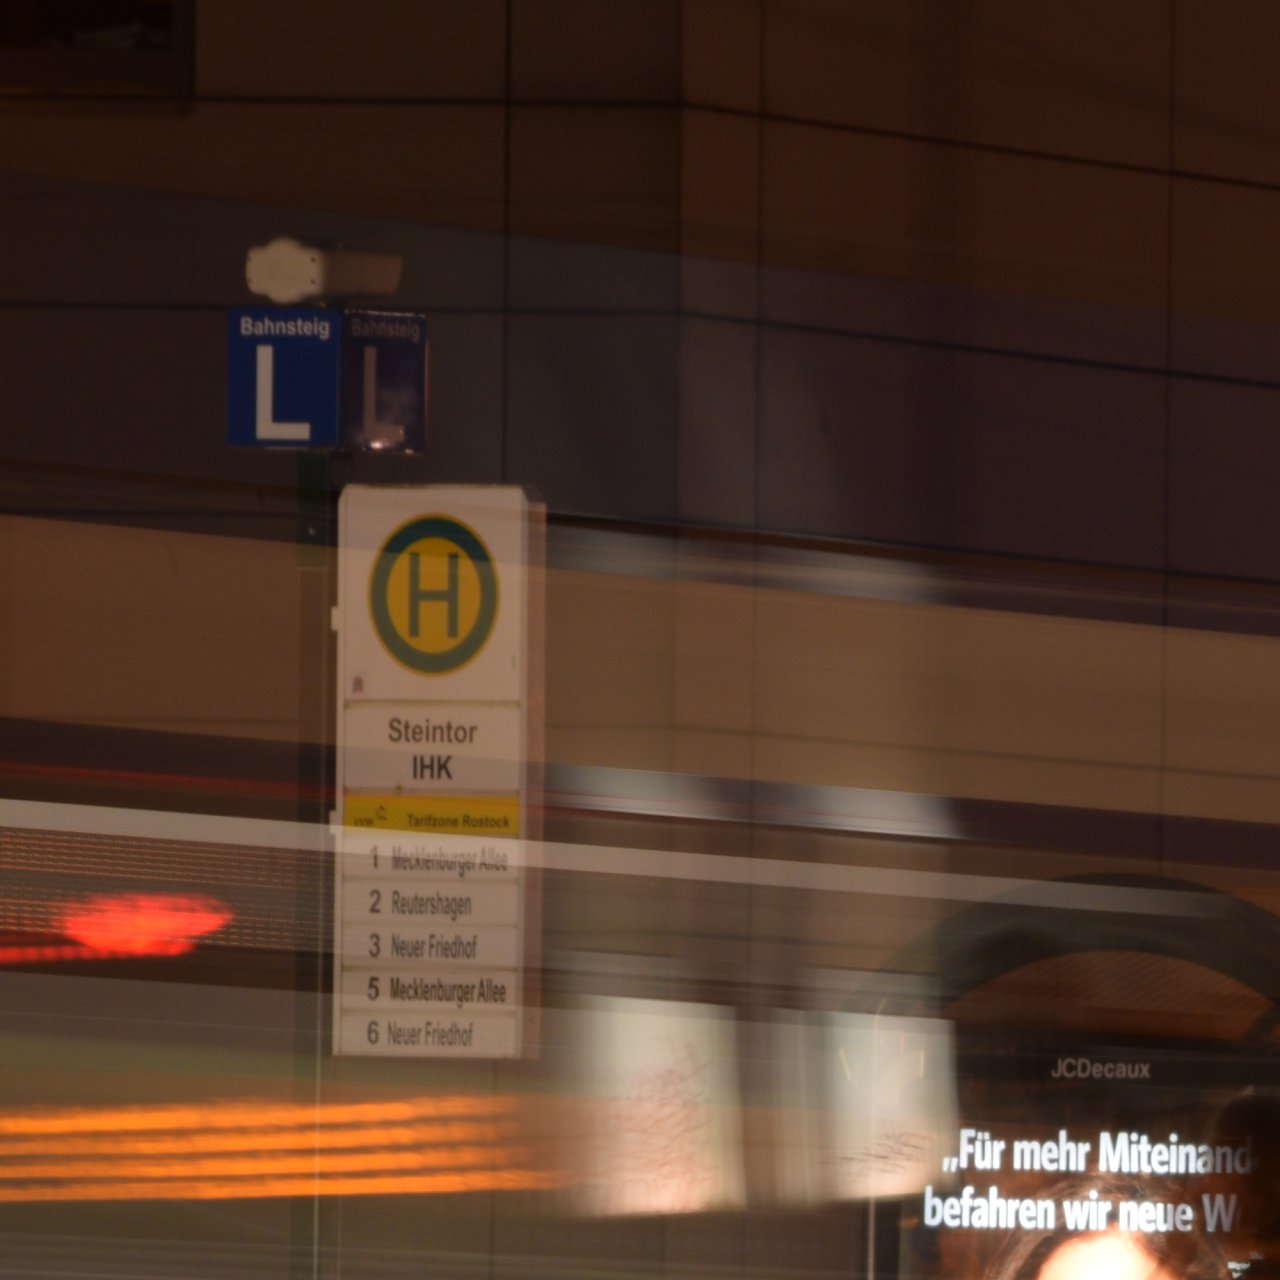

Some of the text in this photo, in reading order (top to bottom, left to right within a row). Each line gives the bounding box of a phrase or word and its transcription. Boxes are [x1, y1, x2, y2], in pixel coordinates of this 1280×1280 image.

[240, 315, 330, 341] Bahnsteig
[351, 318, 421, 343] Bahnsteig
[256, 345, 311, 440] L
[408, 552, 459, 638] H
[388, 717, 478, 744] Steintor
[412, 755, 453, 780] IHK
[407, 813, 510, 829] Tarifzone Rostock
[370, 845, 509, 877] 1 Mecklenburger Allee
[369, 889, 473, 922] 2 Reutershagen
[368, 934, 478, 959] 3 Neuer Friedhof
[367, 977, 507, 1009] 5 Mecklenburger Allee
[367, 1020, 474, 1047] 6 Neuer Friedhof
[1050, 1057, 1152, 1080] JCDecaux
[1012, 1129, 1091, 1172] mehr
[1098, 1130, 1256, 1175] Miteinand
[923, 1184, 1241, 1233] befahren wir neue W
